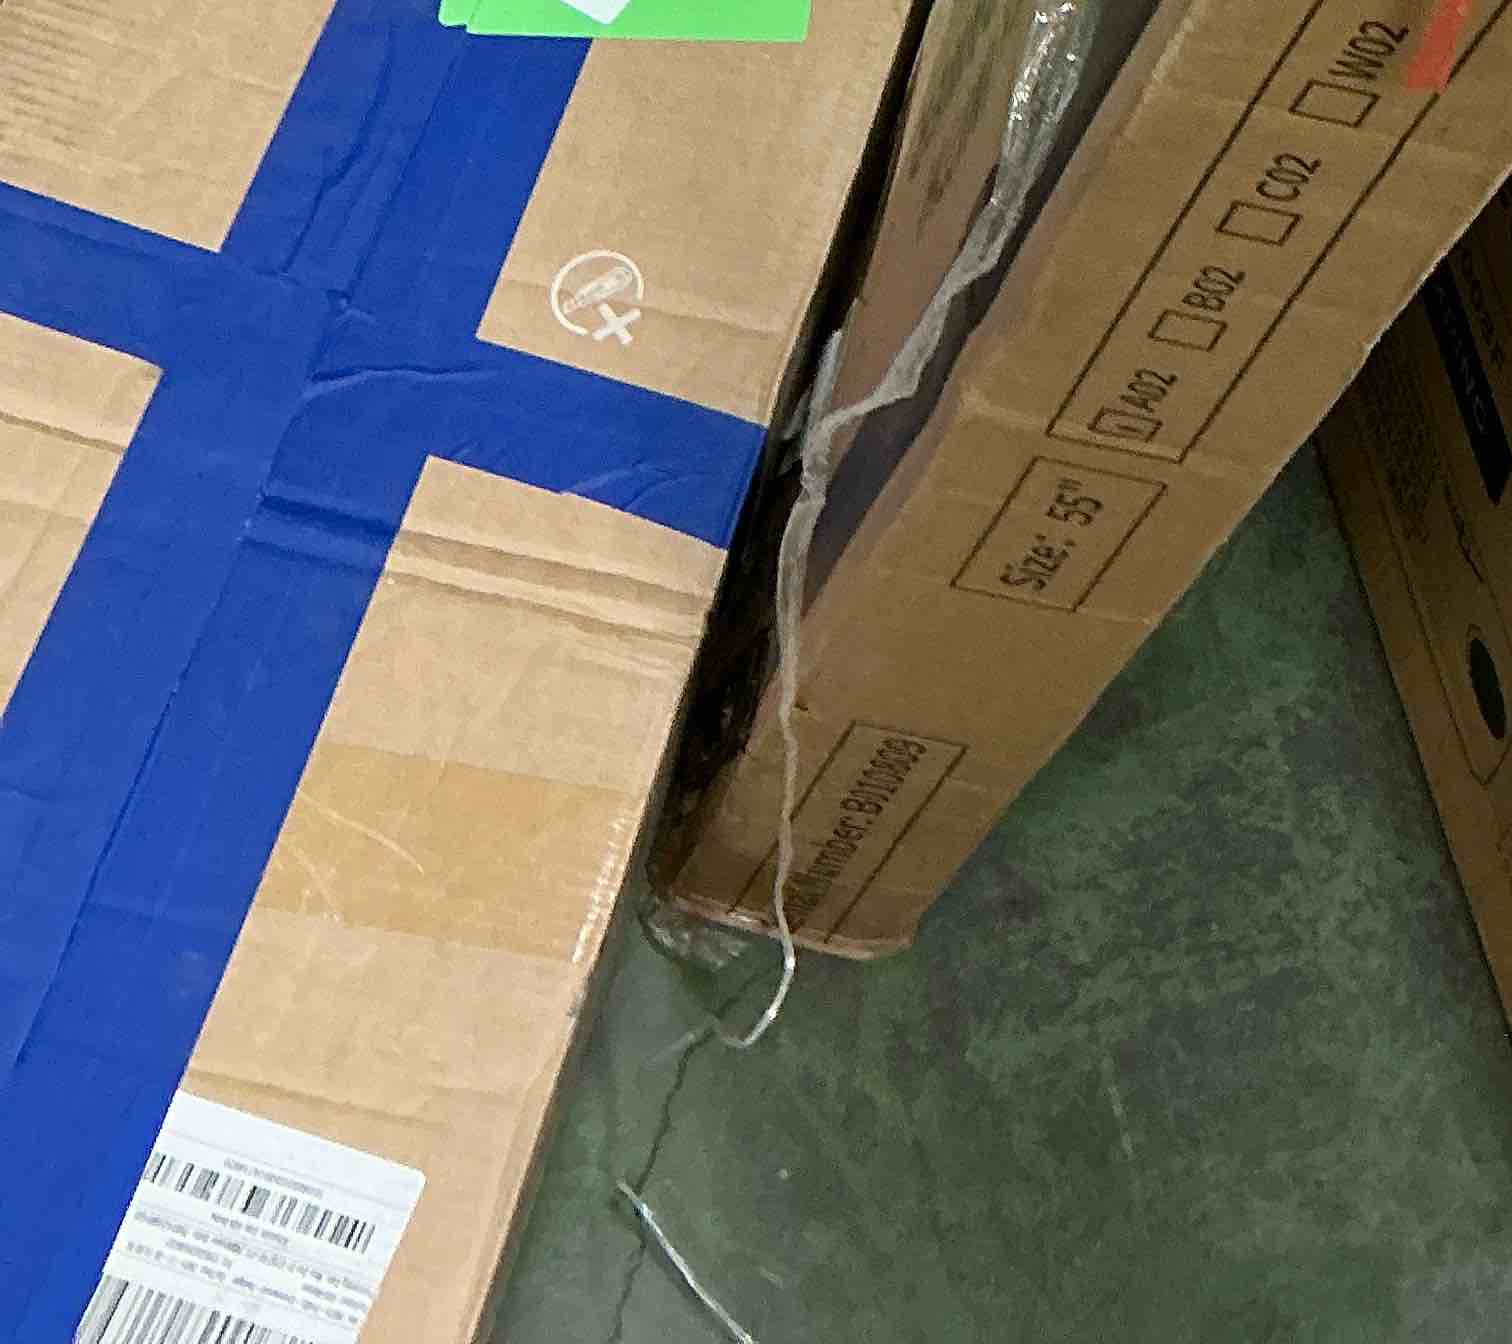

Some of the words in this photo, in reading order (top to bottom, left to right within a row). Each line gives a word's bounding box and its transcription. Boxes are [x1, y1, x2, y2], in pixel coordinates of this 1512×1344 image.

[1329, 18, 1411, 85] W02
[1256, 150, 1322, 203] C02
[1183, 263, 1246, 314] B02
[1133, 366, 1179, 414] A02
[1000, 518, 1078, 591] Size:
